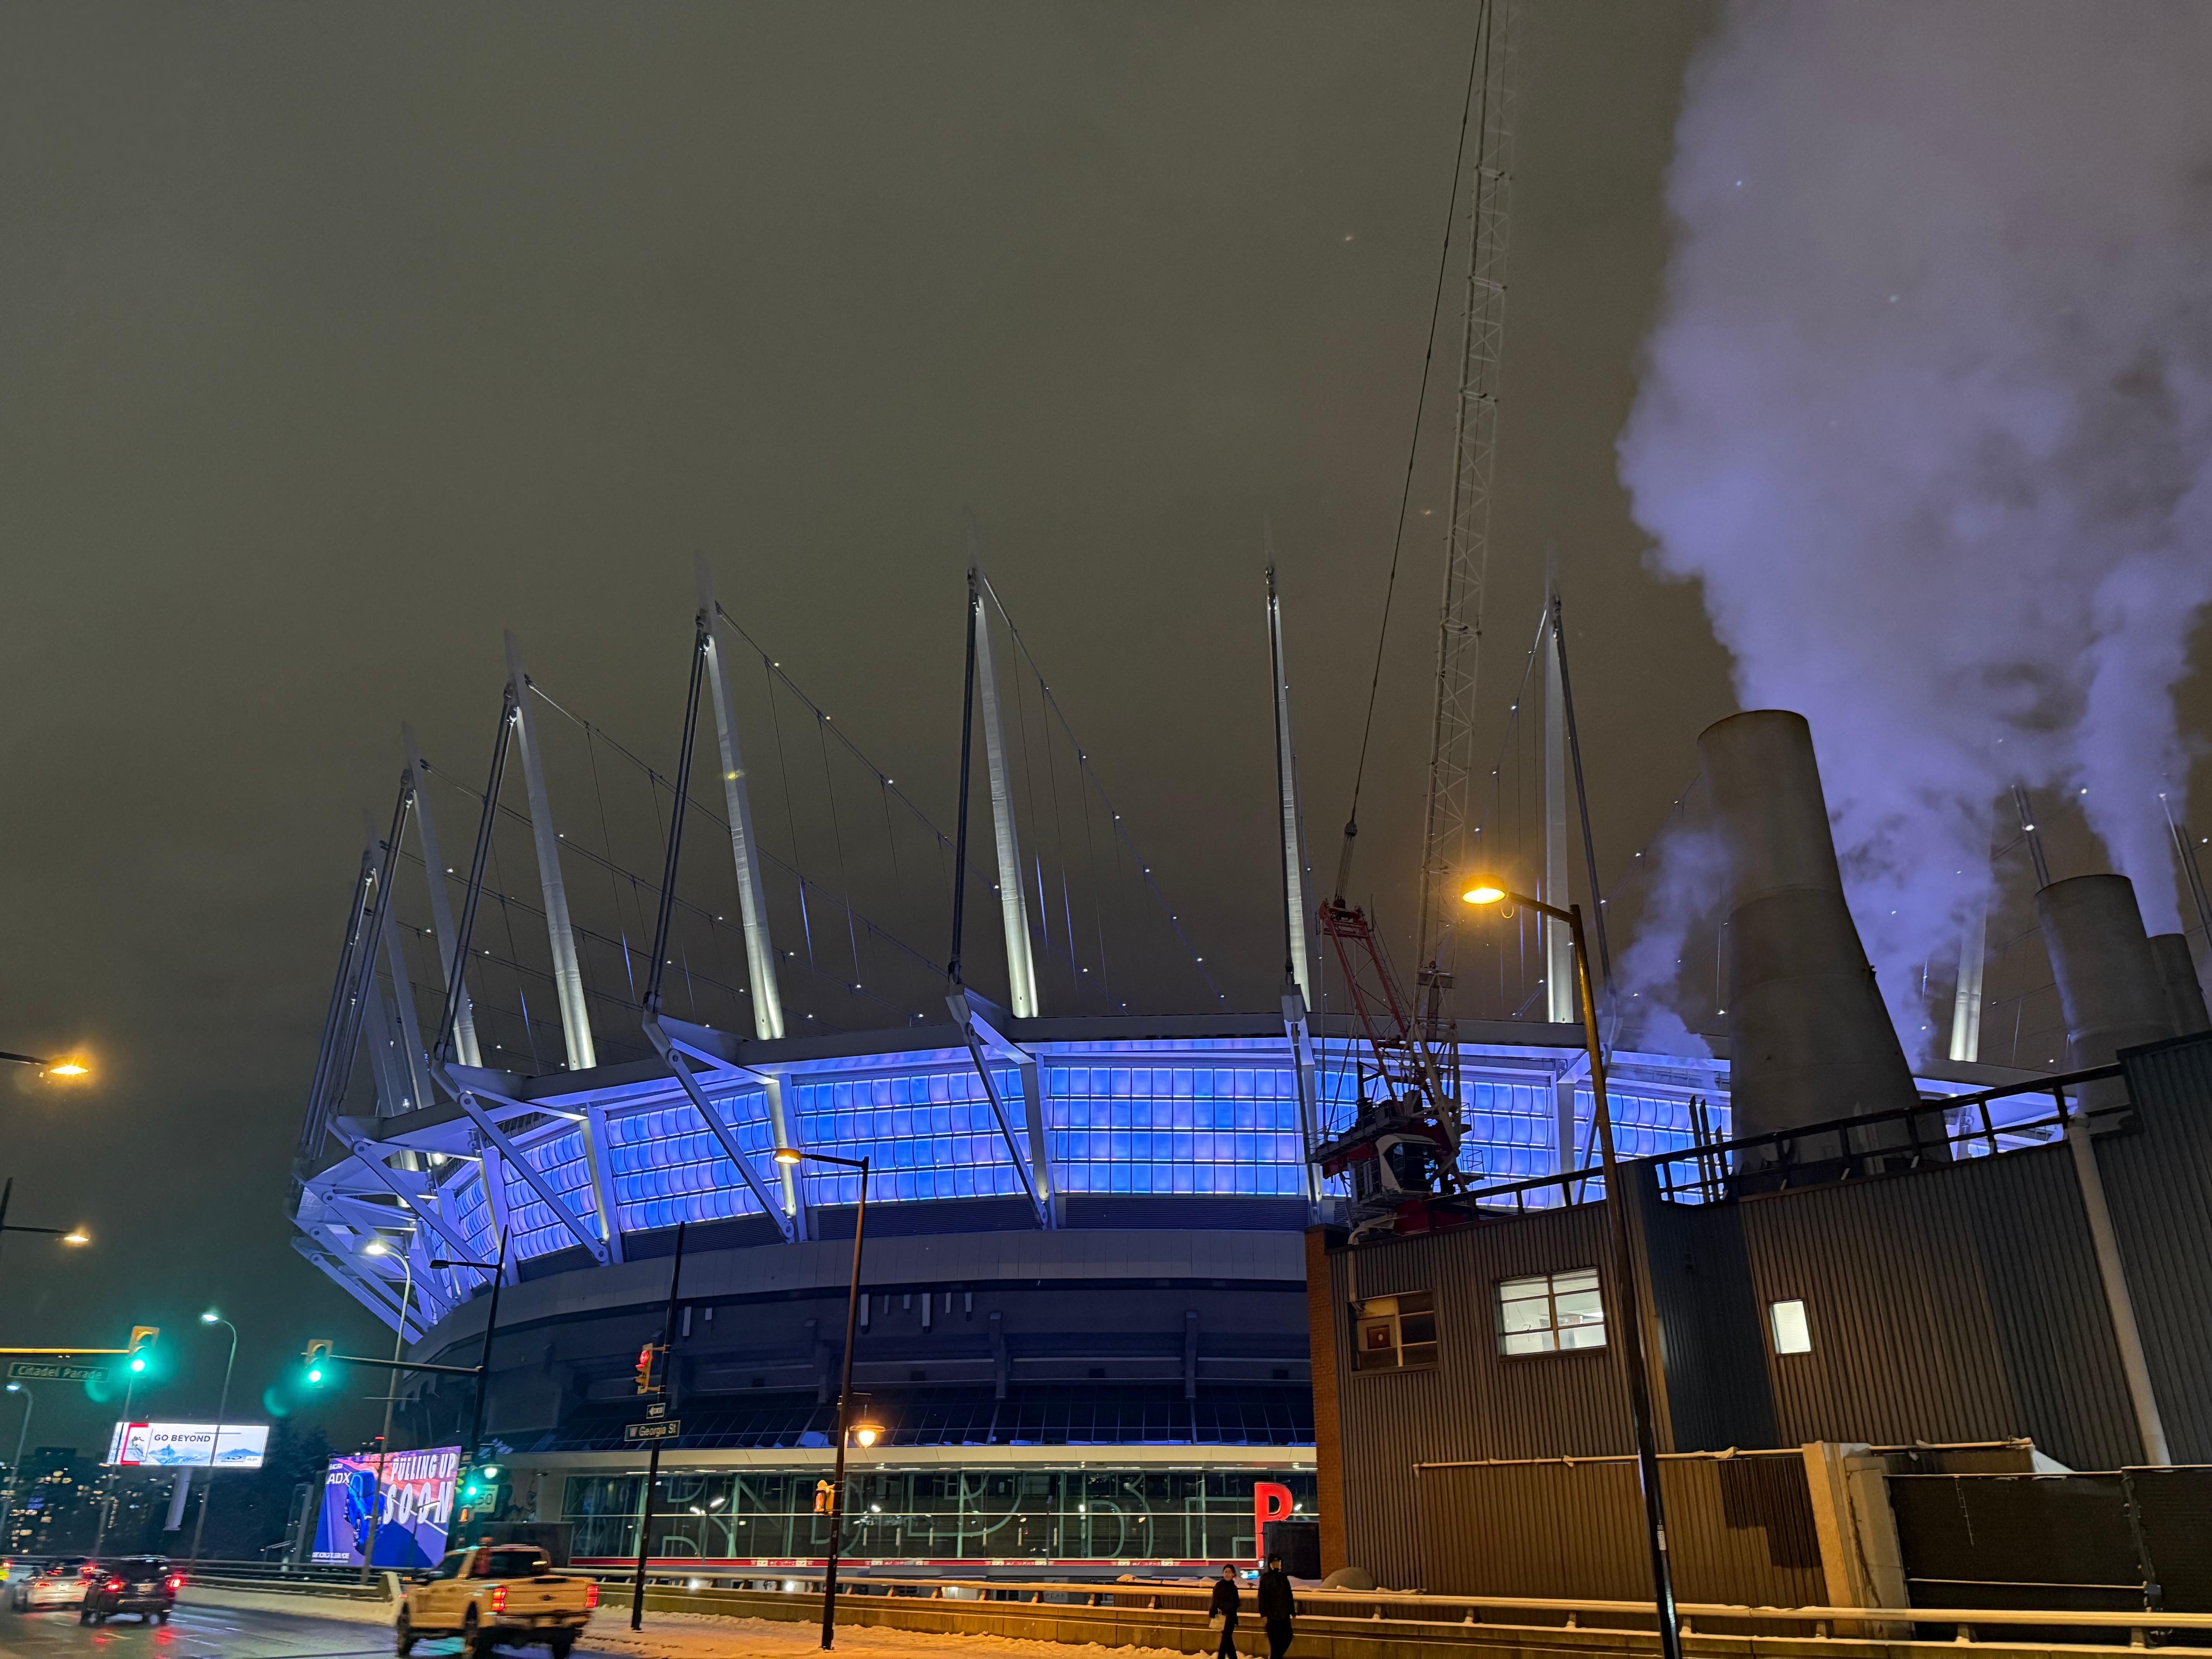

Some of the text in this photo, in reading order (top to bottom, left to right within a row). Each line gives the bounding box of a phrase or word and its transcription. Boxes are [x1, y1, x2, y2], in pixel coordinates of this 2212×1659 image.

[18, 1365, 102, 1379] Citadel Parade
[639, 1424, 666, 1437] Georgia
[668, 1423, 677, 1434] St
[390, 1453, 457, 1482] PULLING UP
[326, 1472, 352, 1484] ADX
[383, 1481, 453, 1525] SOON
[476, 1493, 493, 1505] 50
[1254, 1482, 1293, 1561] P
